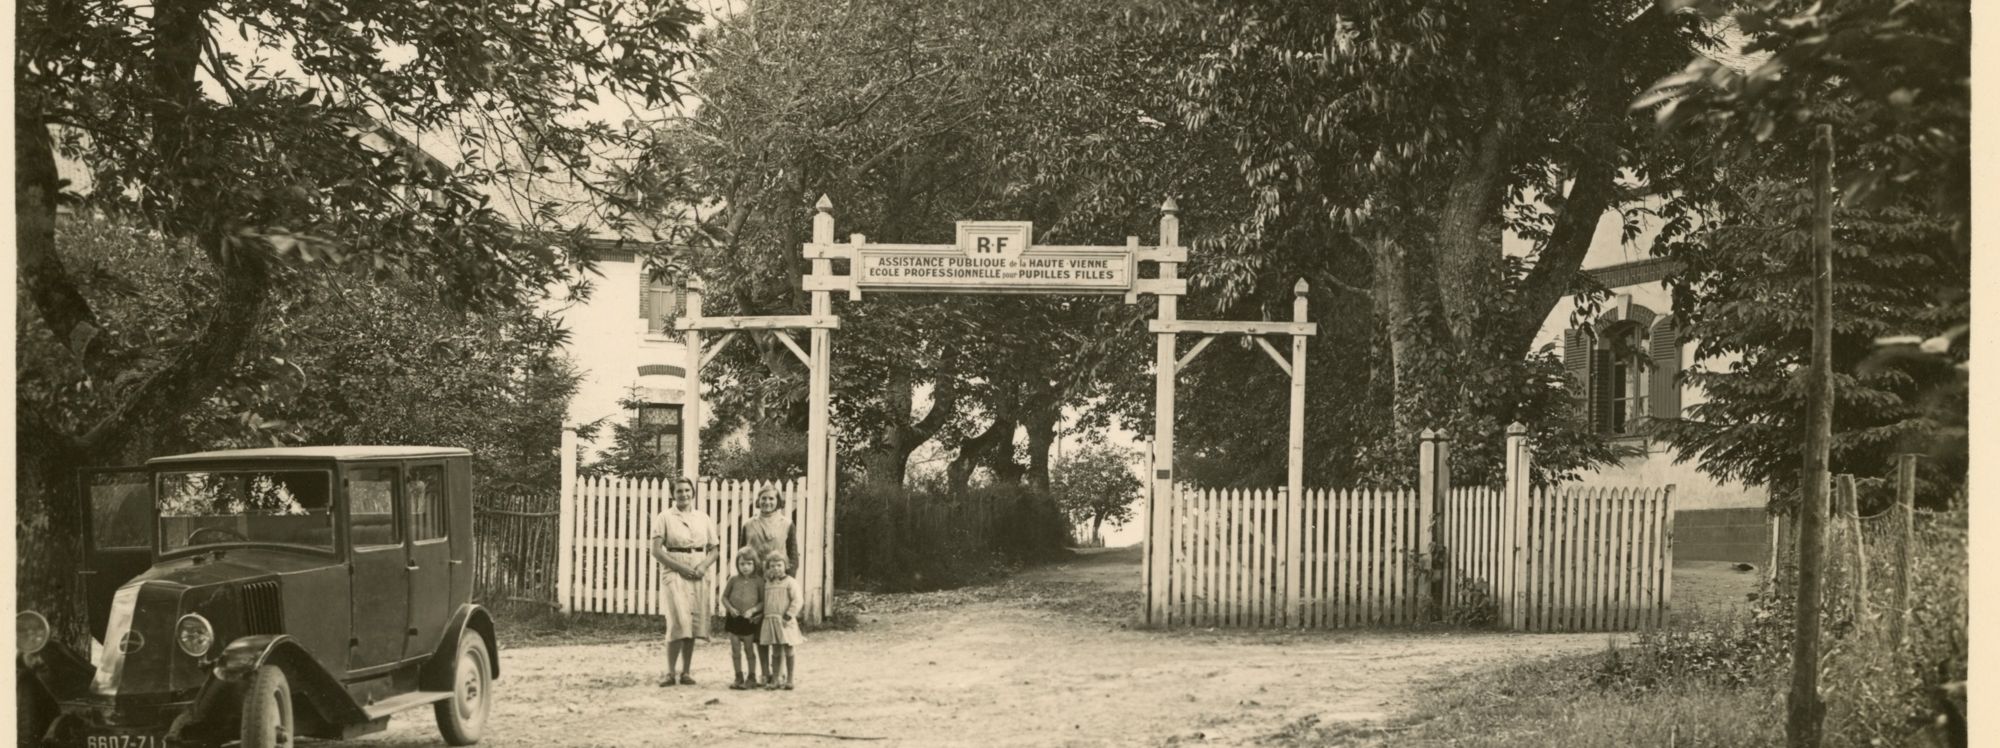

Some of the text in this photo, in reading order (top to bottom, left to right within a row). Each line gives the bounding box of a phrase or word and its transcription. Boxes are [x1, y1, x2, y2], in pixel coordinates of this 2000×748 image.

[878, 256, 944, 267] ASSISTANCE
[948, 257, 1006, 268] PUBLIQUE
[1009, 260, 1018, 268] de
[1019, 258, 1027, 268] la
[869, 267, 1114, 280] ECOLE PROFESSIONNELLE pour PUPILLES FILLES
